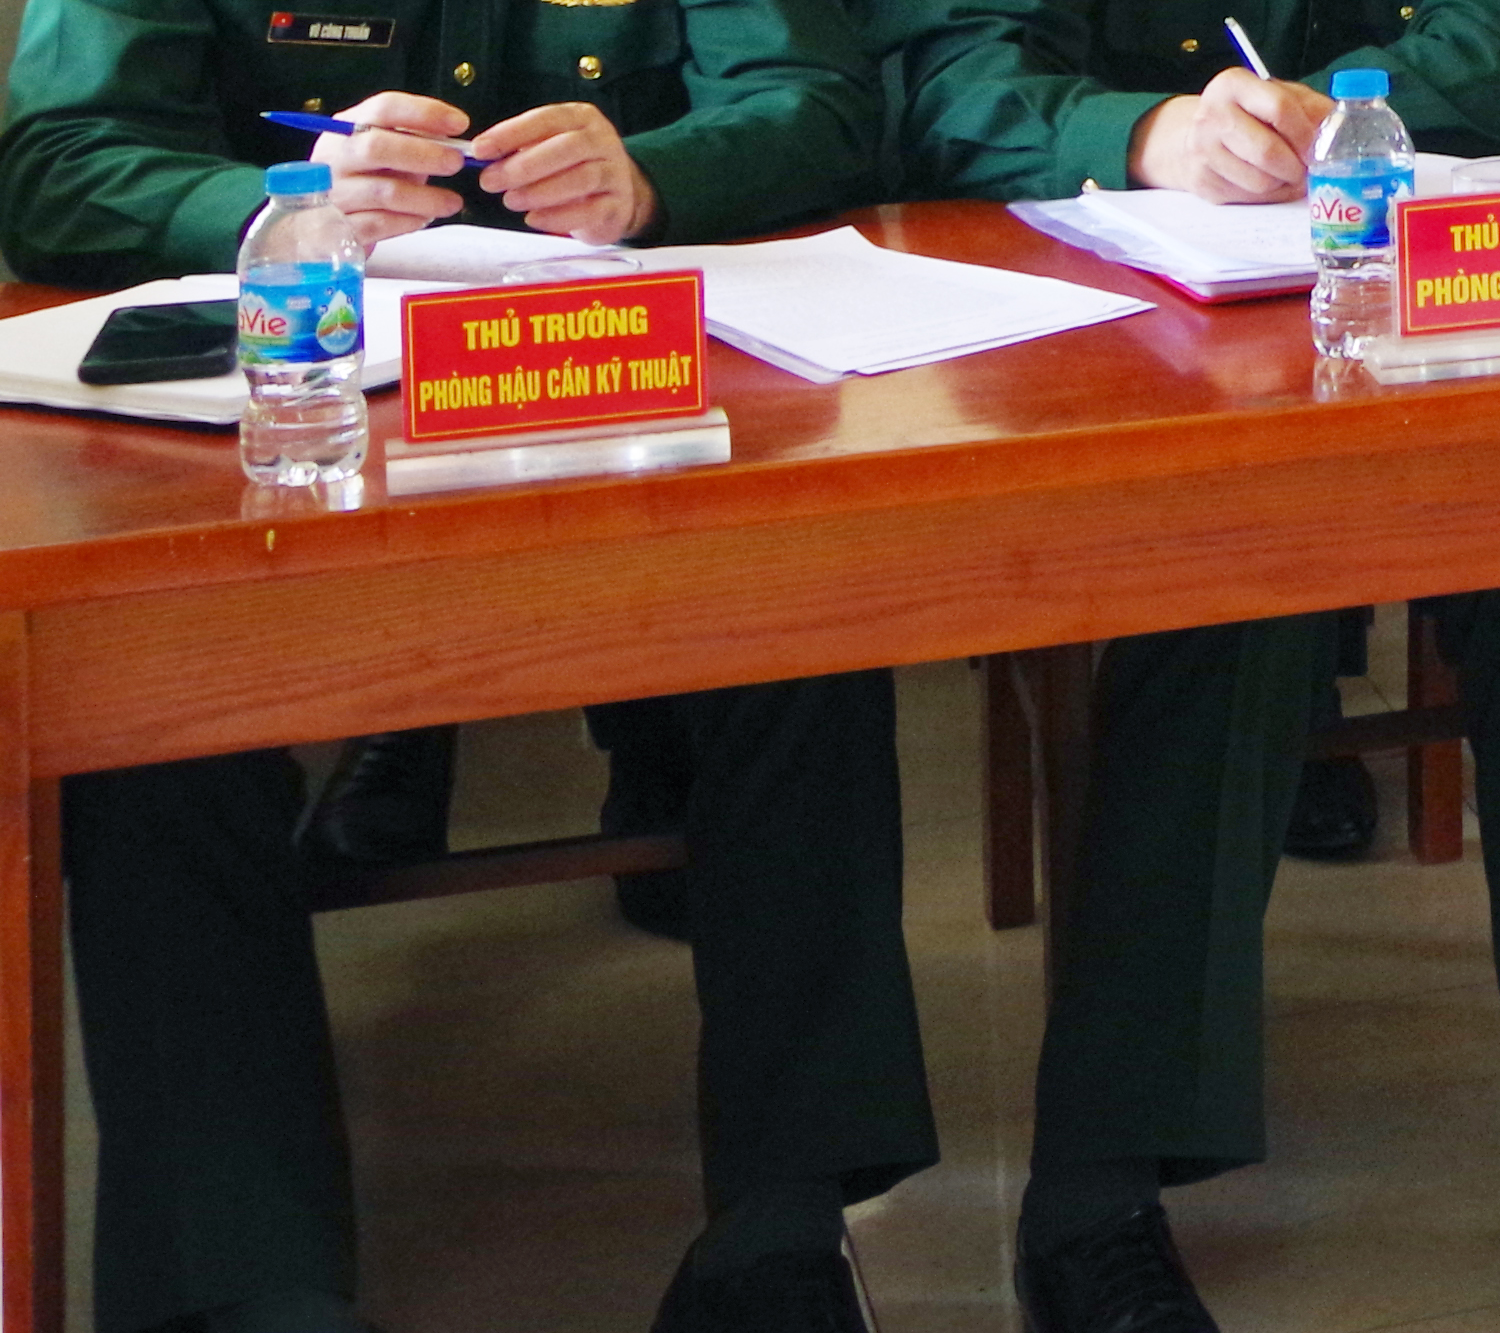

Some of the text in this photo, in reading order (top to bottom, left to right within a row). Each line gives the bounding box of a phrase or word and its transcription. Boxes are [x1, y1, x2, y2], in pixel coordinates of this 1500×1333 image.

[1450, 214, 1500, 253] THỦ
[462, 300, 649, 351] THỦ TRƯỞNG
[419, 370, 493, 412] PHÒNG
[498, 365, 541, 409] HẬU
[596, 356, 623, 395] KỸ
[628, 351, 692, 394] THUẬT
